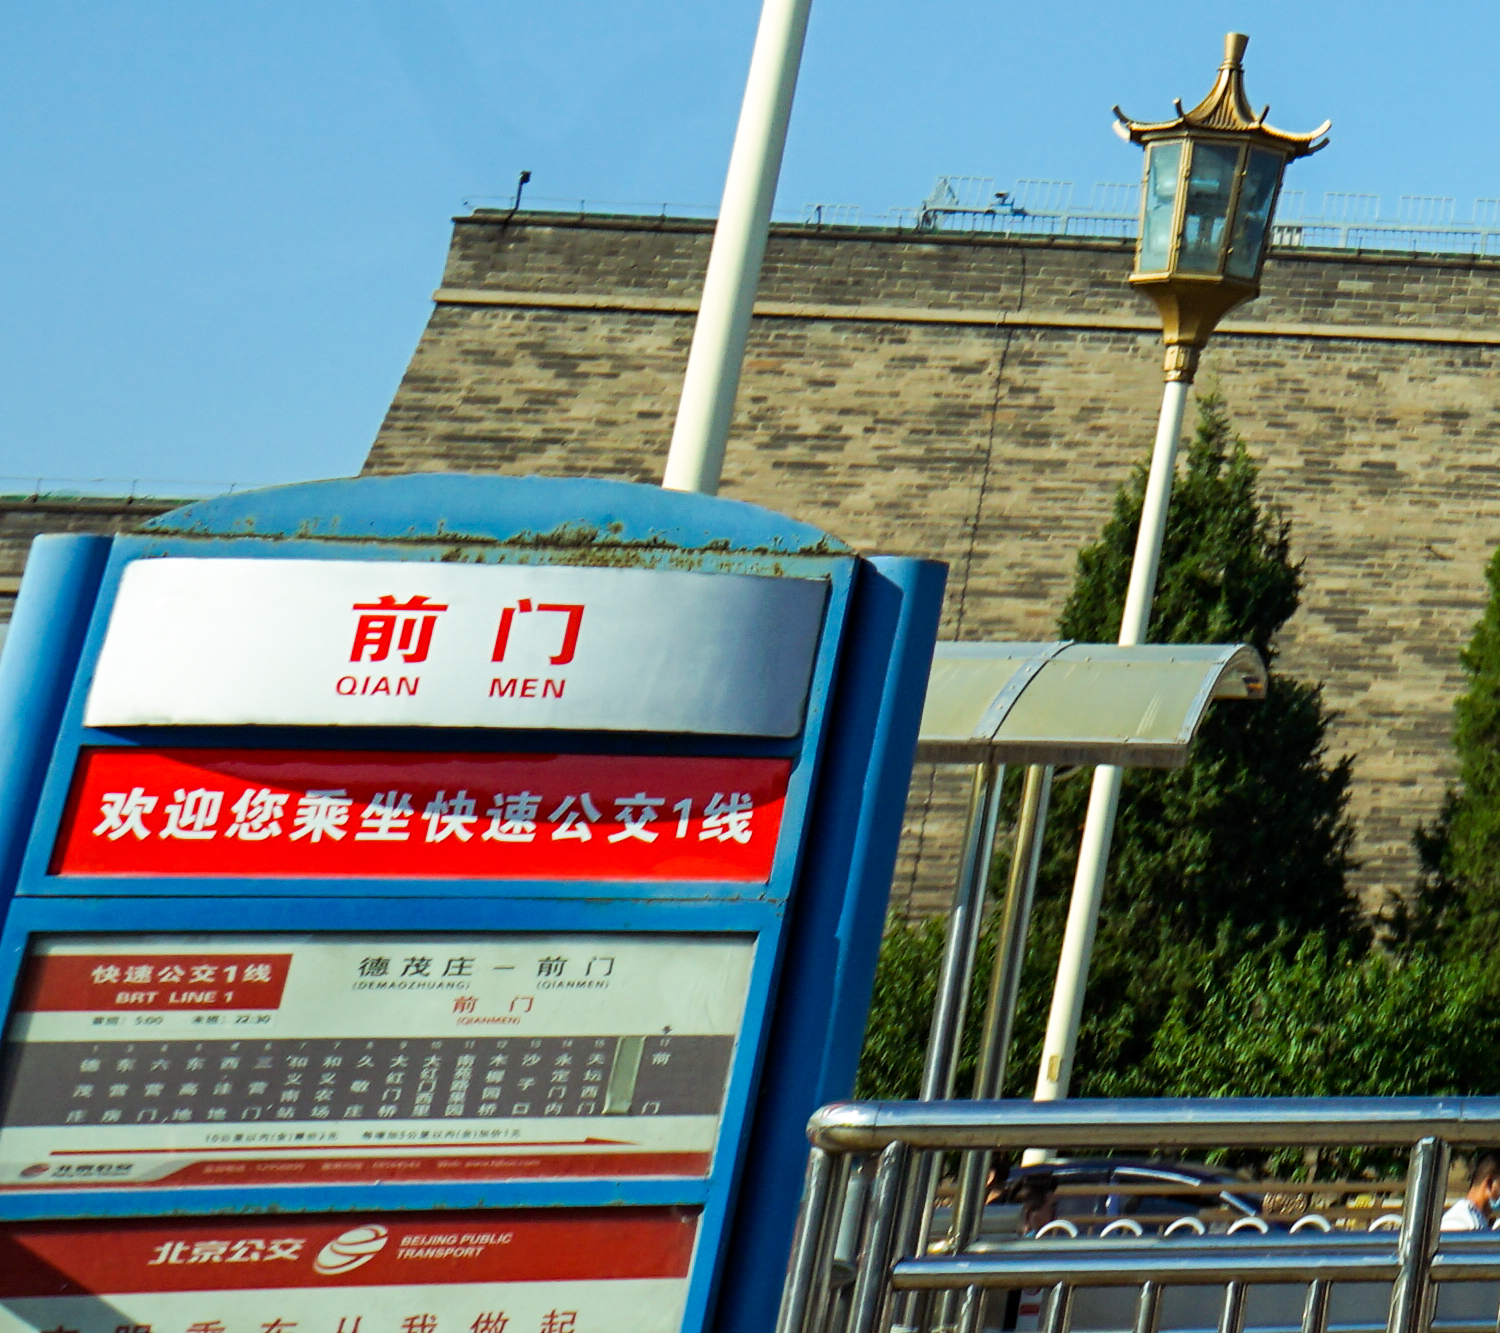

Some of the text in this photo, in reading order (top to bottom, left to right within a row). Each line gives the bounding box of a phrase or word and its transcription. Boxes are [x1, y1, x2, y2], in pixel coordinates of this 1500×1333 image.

[348, 593, 587, 666] 前门
[335, 675, 566, 699] QIAN MEN
[92, 786, 755, 845] 欢迎您乘坐快速公交1线
[91, 964, 273, 985] 快速公交1线
[536, 980, 610, 990] (QIANMEN)
[115, 991, 234, 1005] BRT LINE 1
[452, 995, 535, 1013] 前门
[400, 1232, 514, 1246] BEIJING PUBLIC
[148, 1238, 306, 1266] 北京公交
[397, 1246, 485, 1259] TRANSPORT
